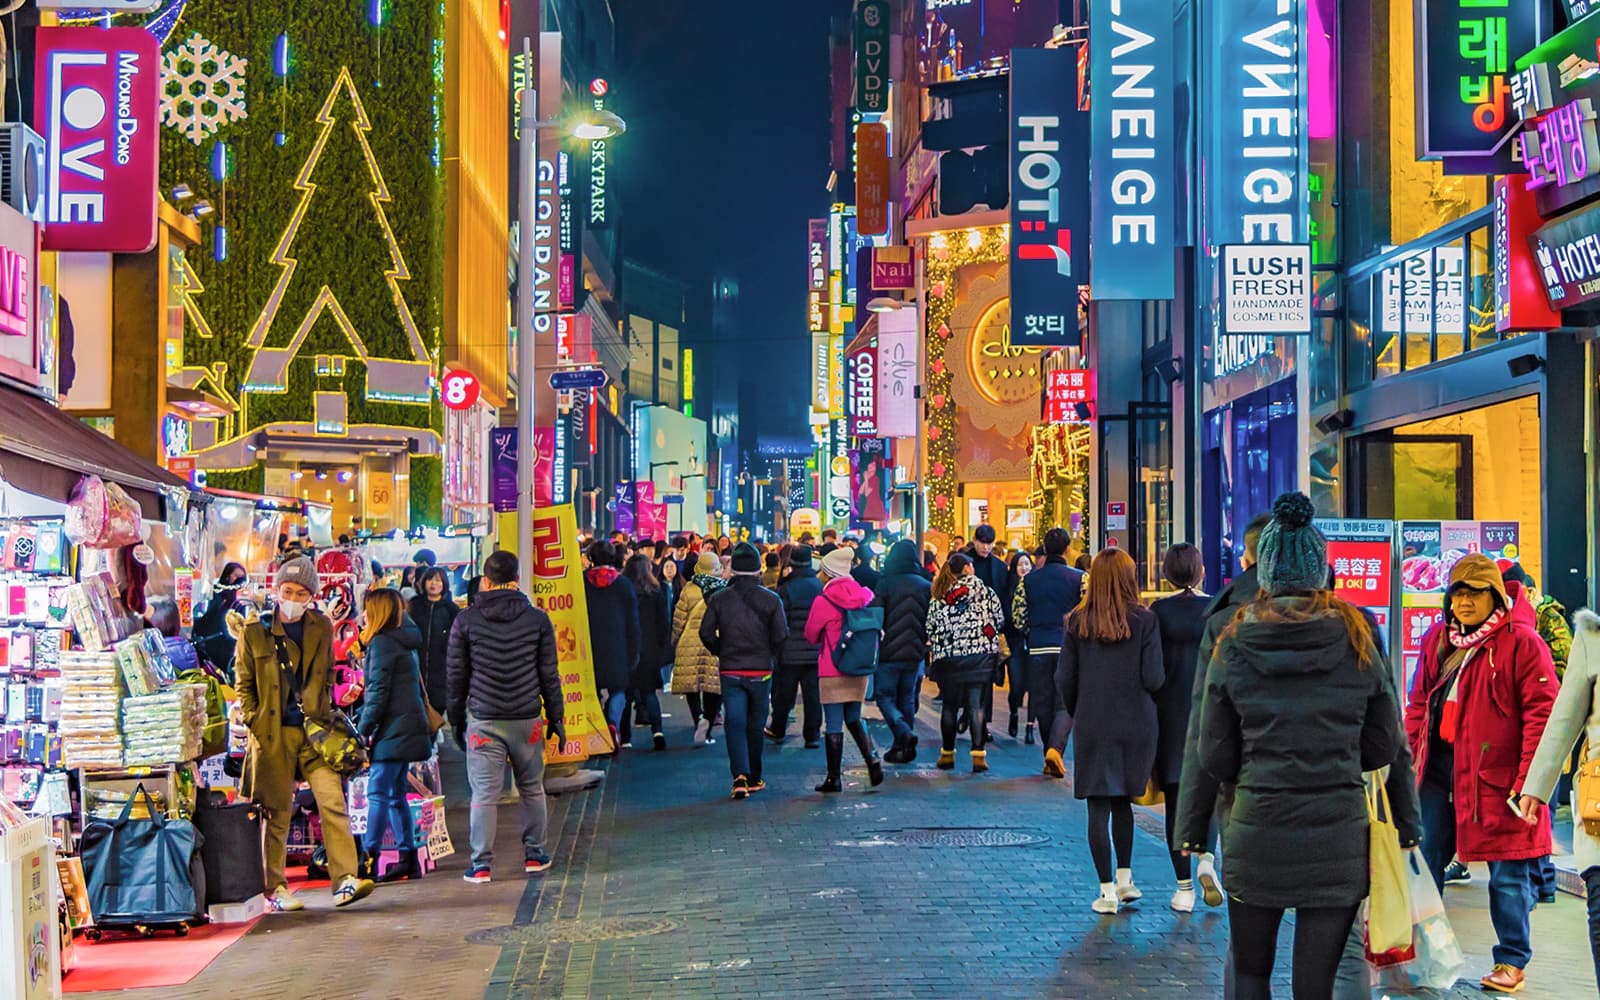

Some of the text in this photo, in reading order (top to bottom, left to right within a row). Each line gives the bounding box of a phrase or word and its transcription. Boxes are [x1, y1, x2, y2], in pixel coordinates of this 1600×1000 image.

[1459, 0, 1511, 132] 래방
[51, 53, 107, 222] LOVE
[1520, 100, 1583, 191] 노래방
[591, 141, 605, 223] SKYPARK
[535, 160, 554, 331] GIORDANO
[876, 264, 911, 276] Nail
[1232, 257, 1303, 275] LUSH
[1232, 279, 1303, 295] FRESH
[1232, 299, 1303, 309] HANDMADE
[1024, 314, 1065, 335] 핫티
[1233, 311, 1304, 321] COSMETICS
[857, 352, 873, 417] COFFEE
[554, 449, 564, 503] FRIENDS
[1334, 558, 1381, 576] 美容室
